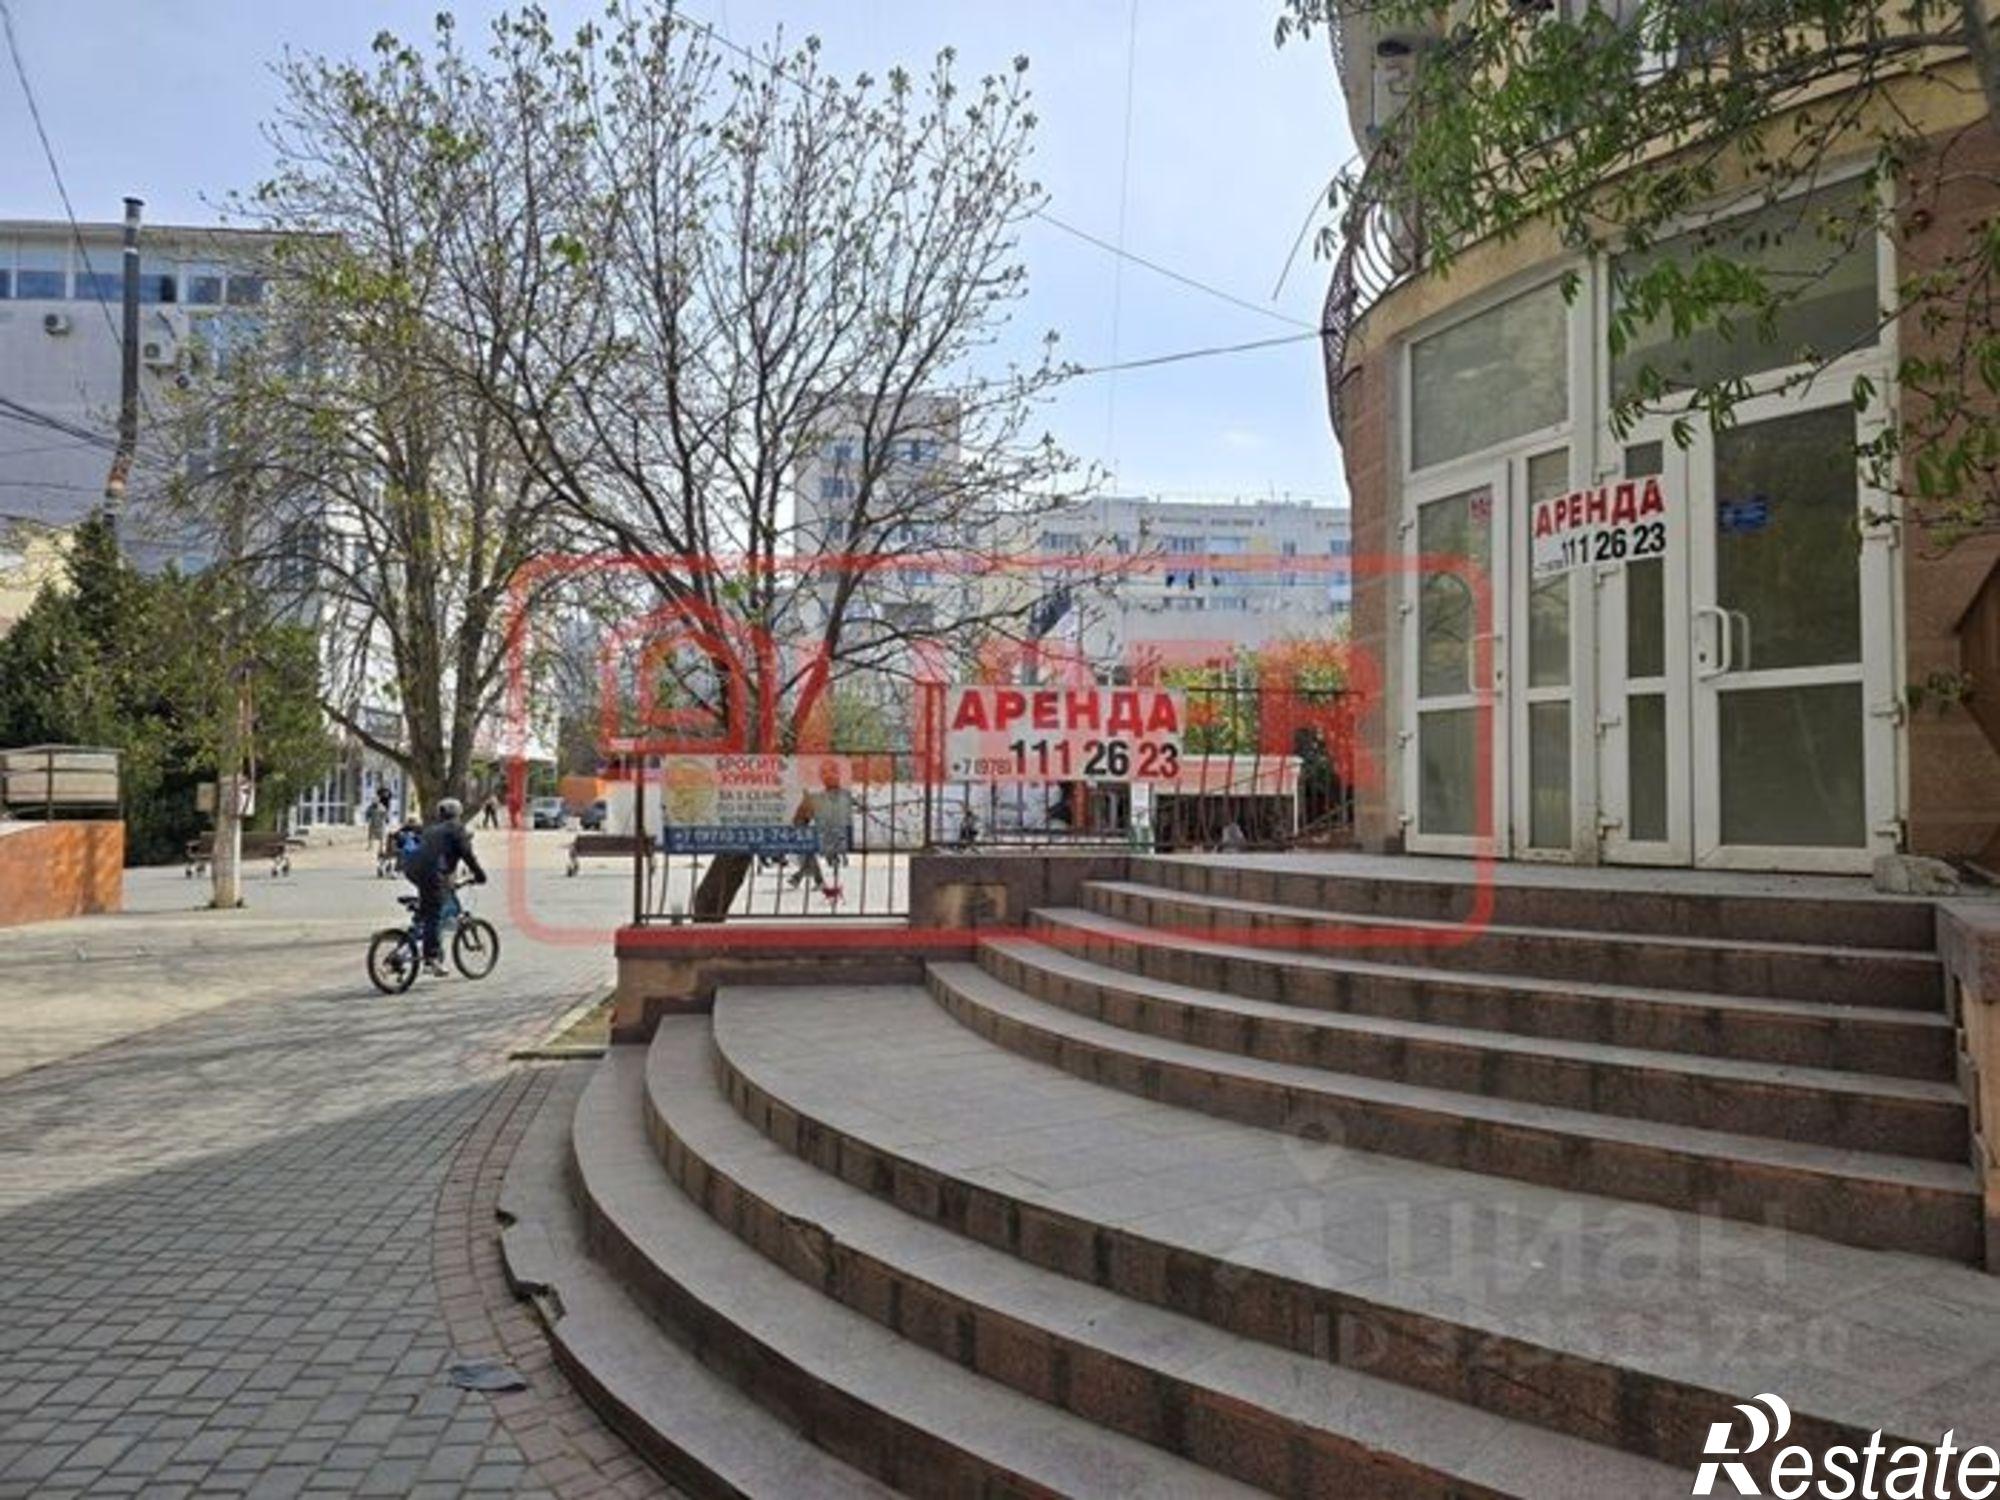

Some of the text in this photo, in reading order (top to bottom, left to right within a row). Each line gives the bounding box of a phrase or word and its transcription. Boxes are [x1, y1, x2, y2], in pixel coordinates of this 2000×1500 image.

[1535, 478, 1665, 539] АРЕНДА
[1594, 528, 1627, 561] 26
[1633, 522, 1666, 555] 23
[952, 689, 1179, 738] АРЕНДА
[1010, 740, 1072, 775] 111
[1083, 740, 1130, 776] 26
[1137, 742, 1179, 778] 23
